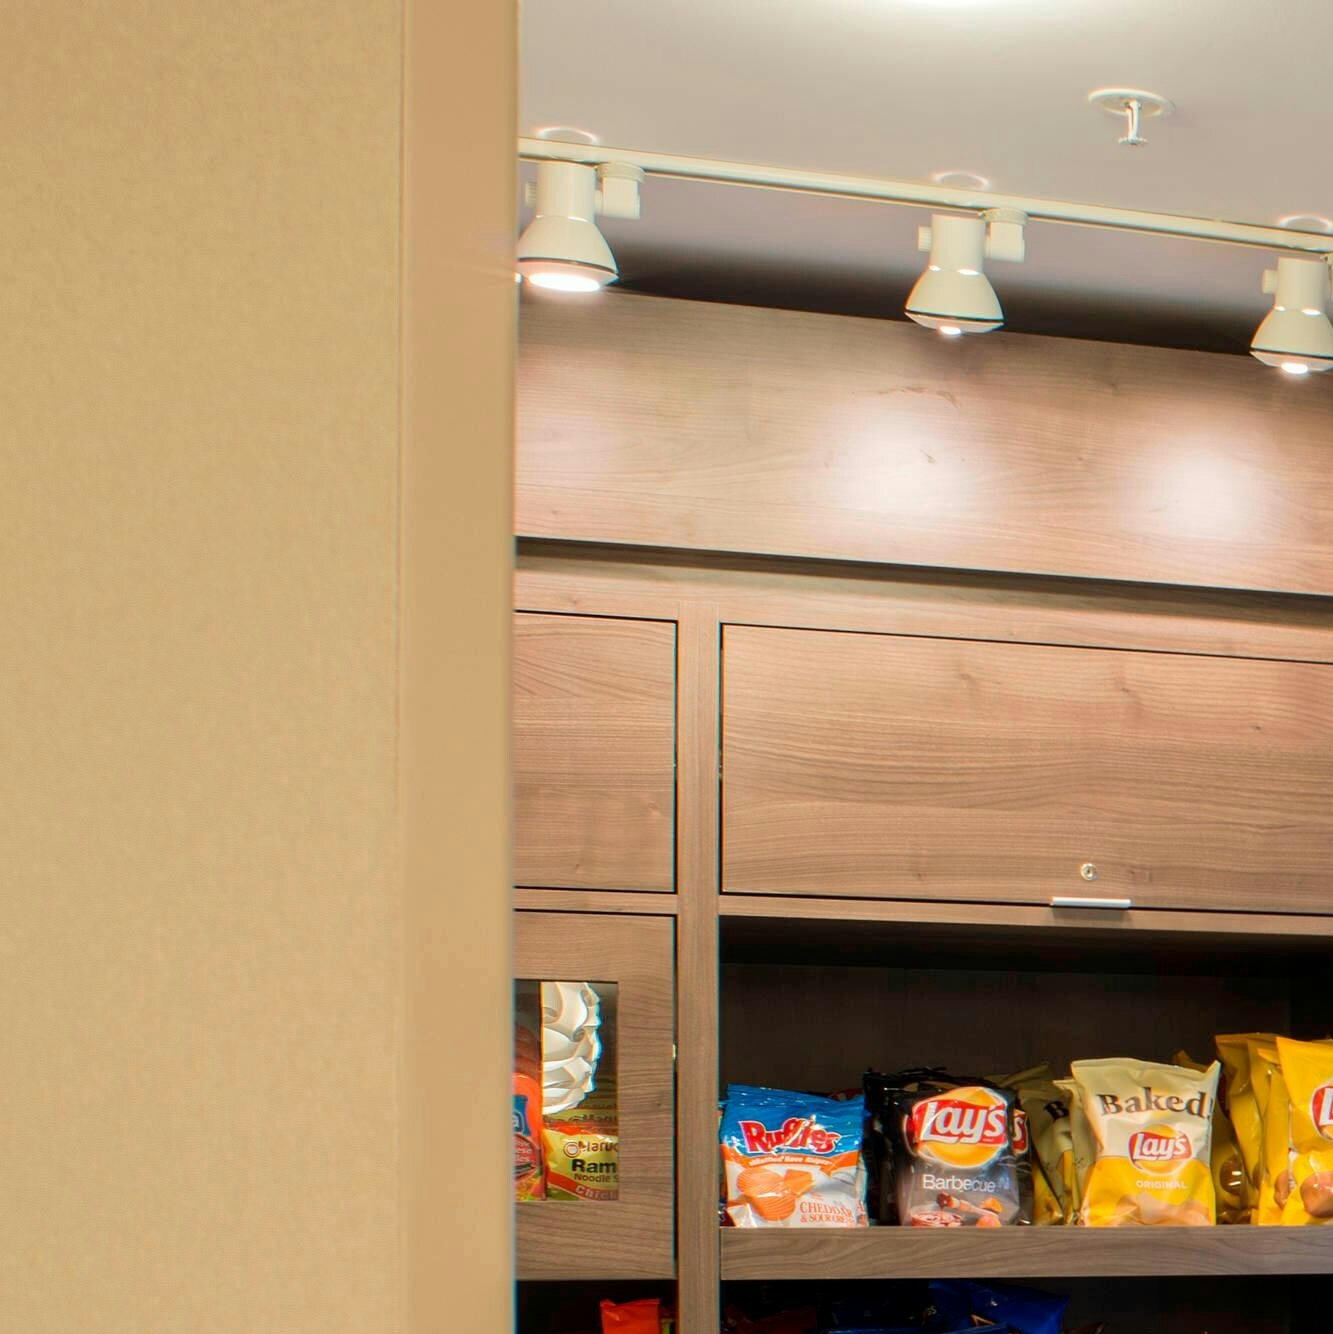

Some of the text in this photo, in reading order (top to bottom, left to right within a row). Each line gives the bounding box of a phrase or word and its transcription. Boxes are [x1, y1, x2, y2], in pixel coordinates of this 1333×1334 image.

[738, 1115, 842, 1154] Ruffles
[920, 1100, 1007, 1144] Lay's
[1133, 1132, 1187, 1161] Lay's
[922, 1174, 997, 1194] Barbecue
